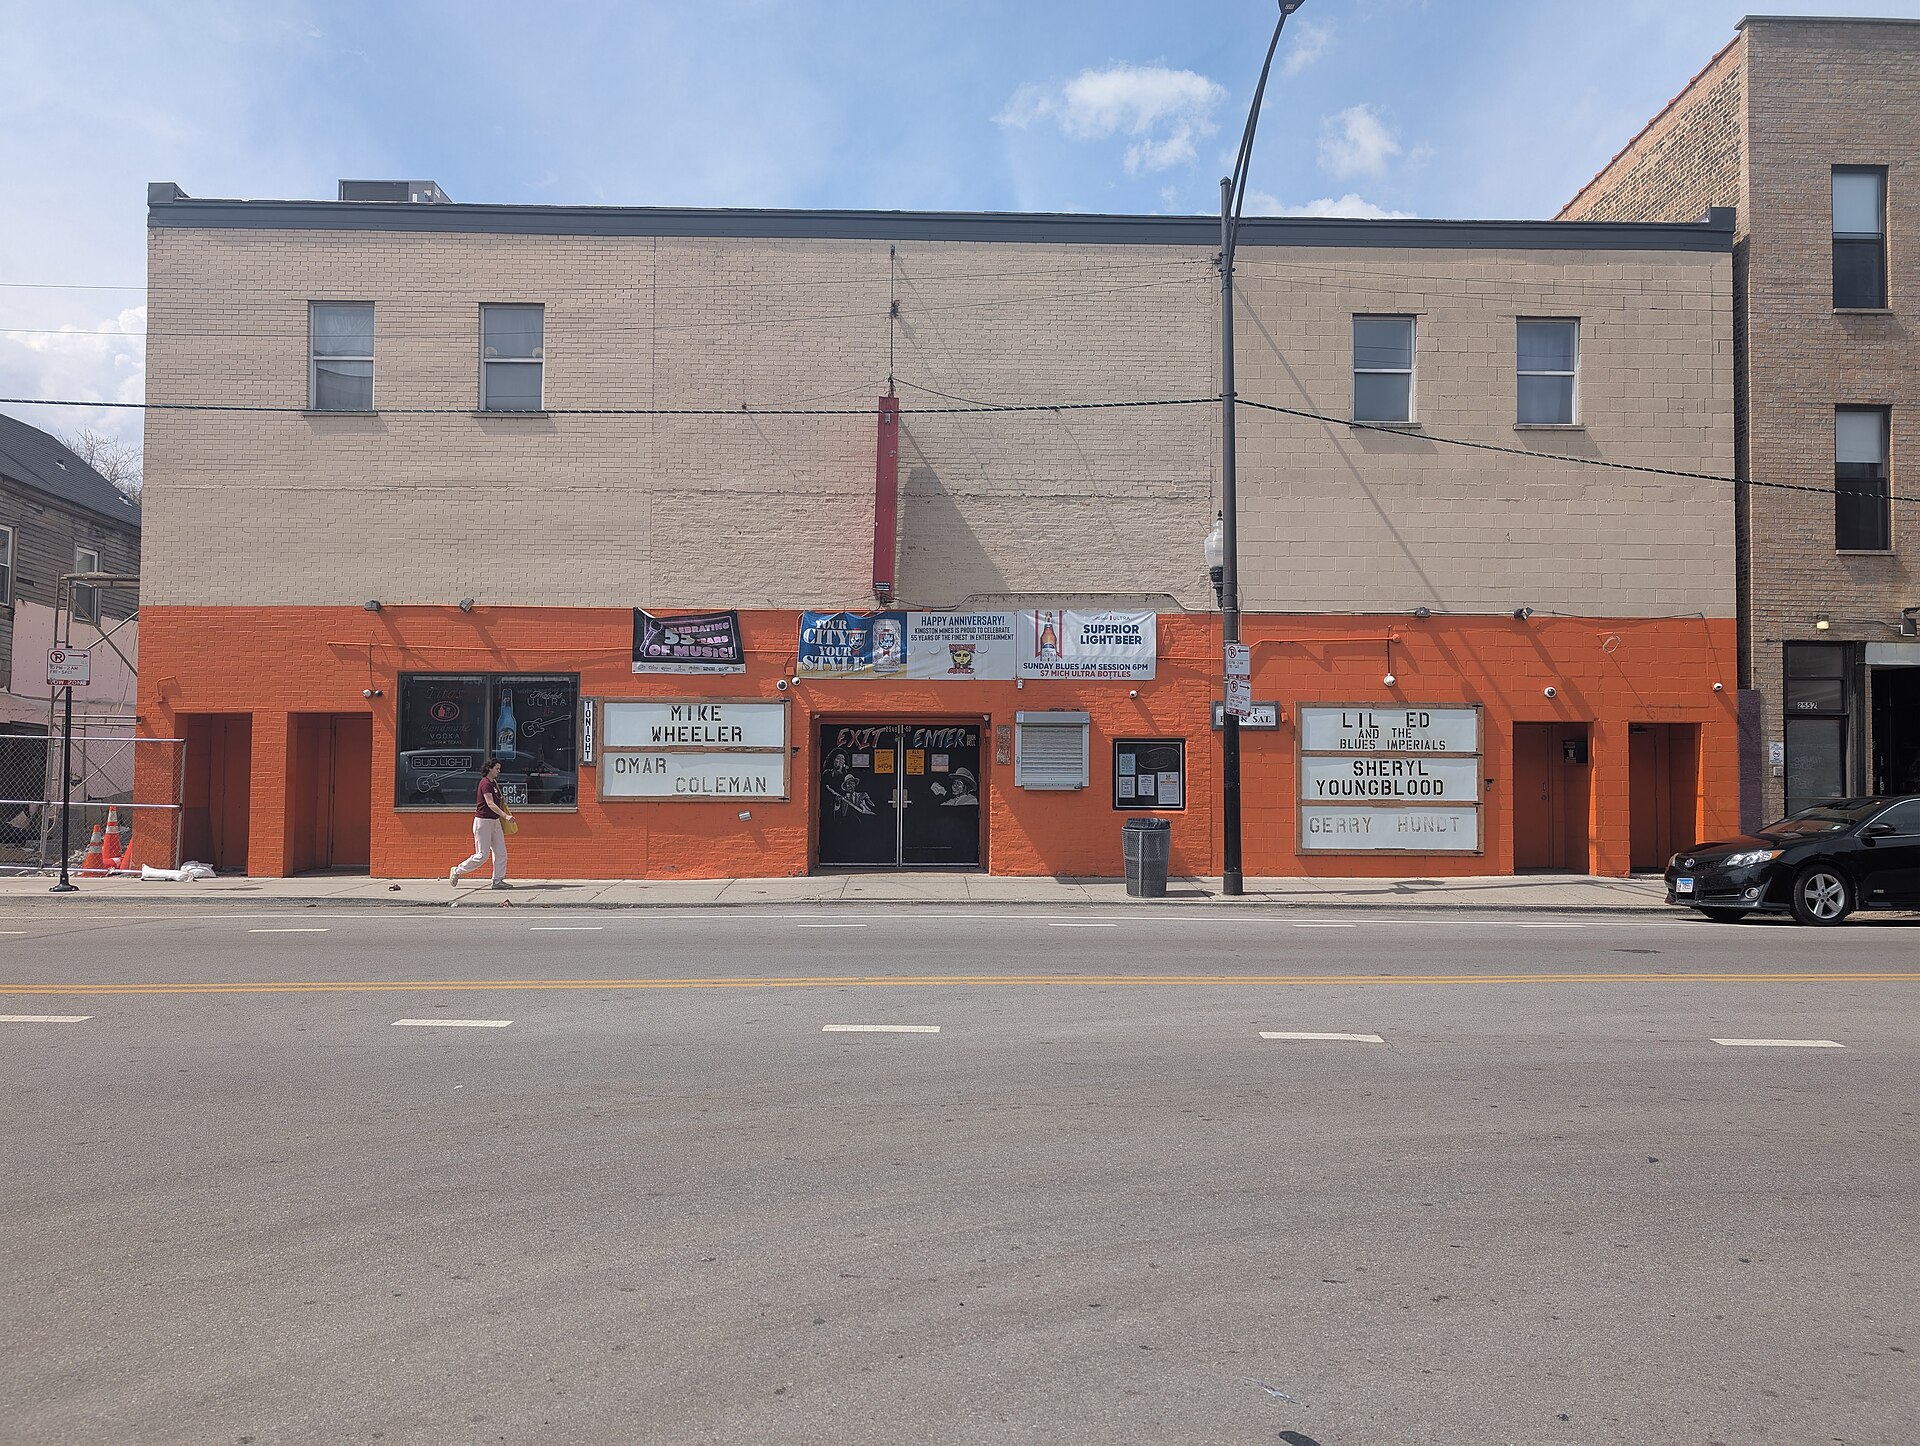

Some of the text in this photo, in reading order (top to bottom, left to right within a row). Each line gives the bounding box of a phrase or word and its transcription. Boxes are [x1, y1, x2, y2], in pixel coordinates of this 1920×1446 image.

[815, 620, 847, 629] YOUR
[921, 615, 1005, 626] HAPPY ANNIVERSARY!
[671, 622, 730, 634] LEBRATING
[983, 626, 1010, 634] CELEBRATE
[1083, 624, 1139, 634] SUPERIOR
[697, 635, 729, 645] EARS
[803, 628, 850, 646] CITY
[910, 634, 918, 642] 55
[1080, 635, 1142, 645] LIGHT BEER
[648, 644, 734, 658] OF MUSIC!
[819, 646, 852, 656] YOUR
[802, 655, 865, 671] STYLE
[1023, 662, 1054, 670] SUNDAY
[1097, 670, 1131, 678] BOTTLES
[527, 697, 568, 706] ULTRA
[1797, 701, 1818, 709] 2552
[671, 705, 722, 722] MIKE
[1252, 715, 1272, 723] SAT.
[1342, 712, 1430, 728] LIL ED
[584, 701, 593, 760] TONIGHT
[651, 726, 743, 742] WHEELER
[1358, 728, 1412, 739] AND THE
[836, 727, 886, 750] EXIT
[913, 727, 966, 748] ENTER
[1340, 739, 1446, 751] BLUES IMPERIALS
[413, 757, 470, 767] BUD LIGHT
[615, 757, 667, 774] OMAR
[1353, 760, 1429, 776] SHERYL
[502, 784, 517, 795] got
[675, 777, 767, 793] COLEMAN
[1316, 779, 1444, 796] YOUNGBLOOD
[1309, 816, 1460, 833] GERRY HUNDT
